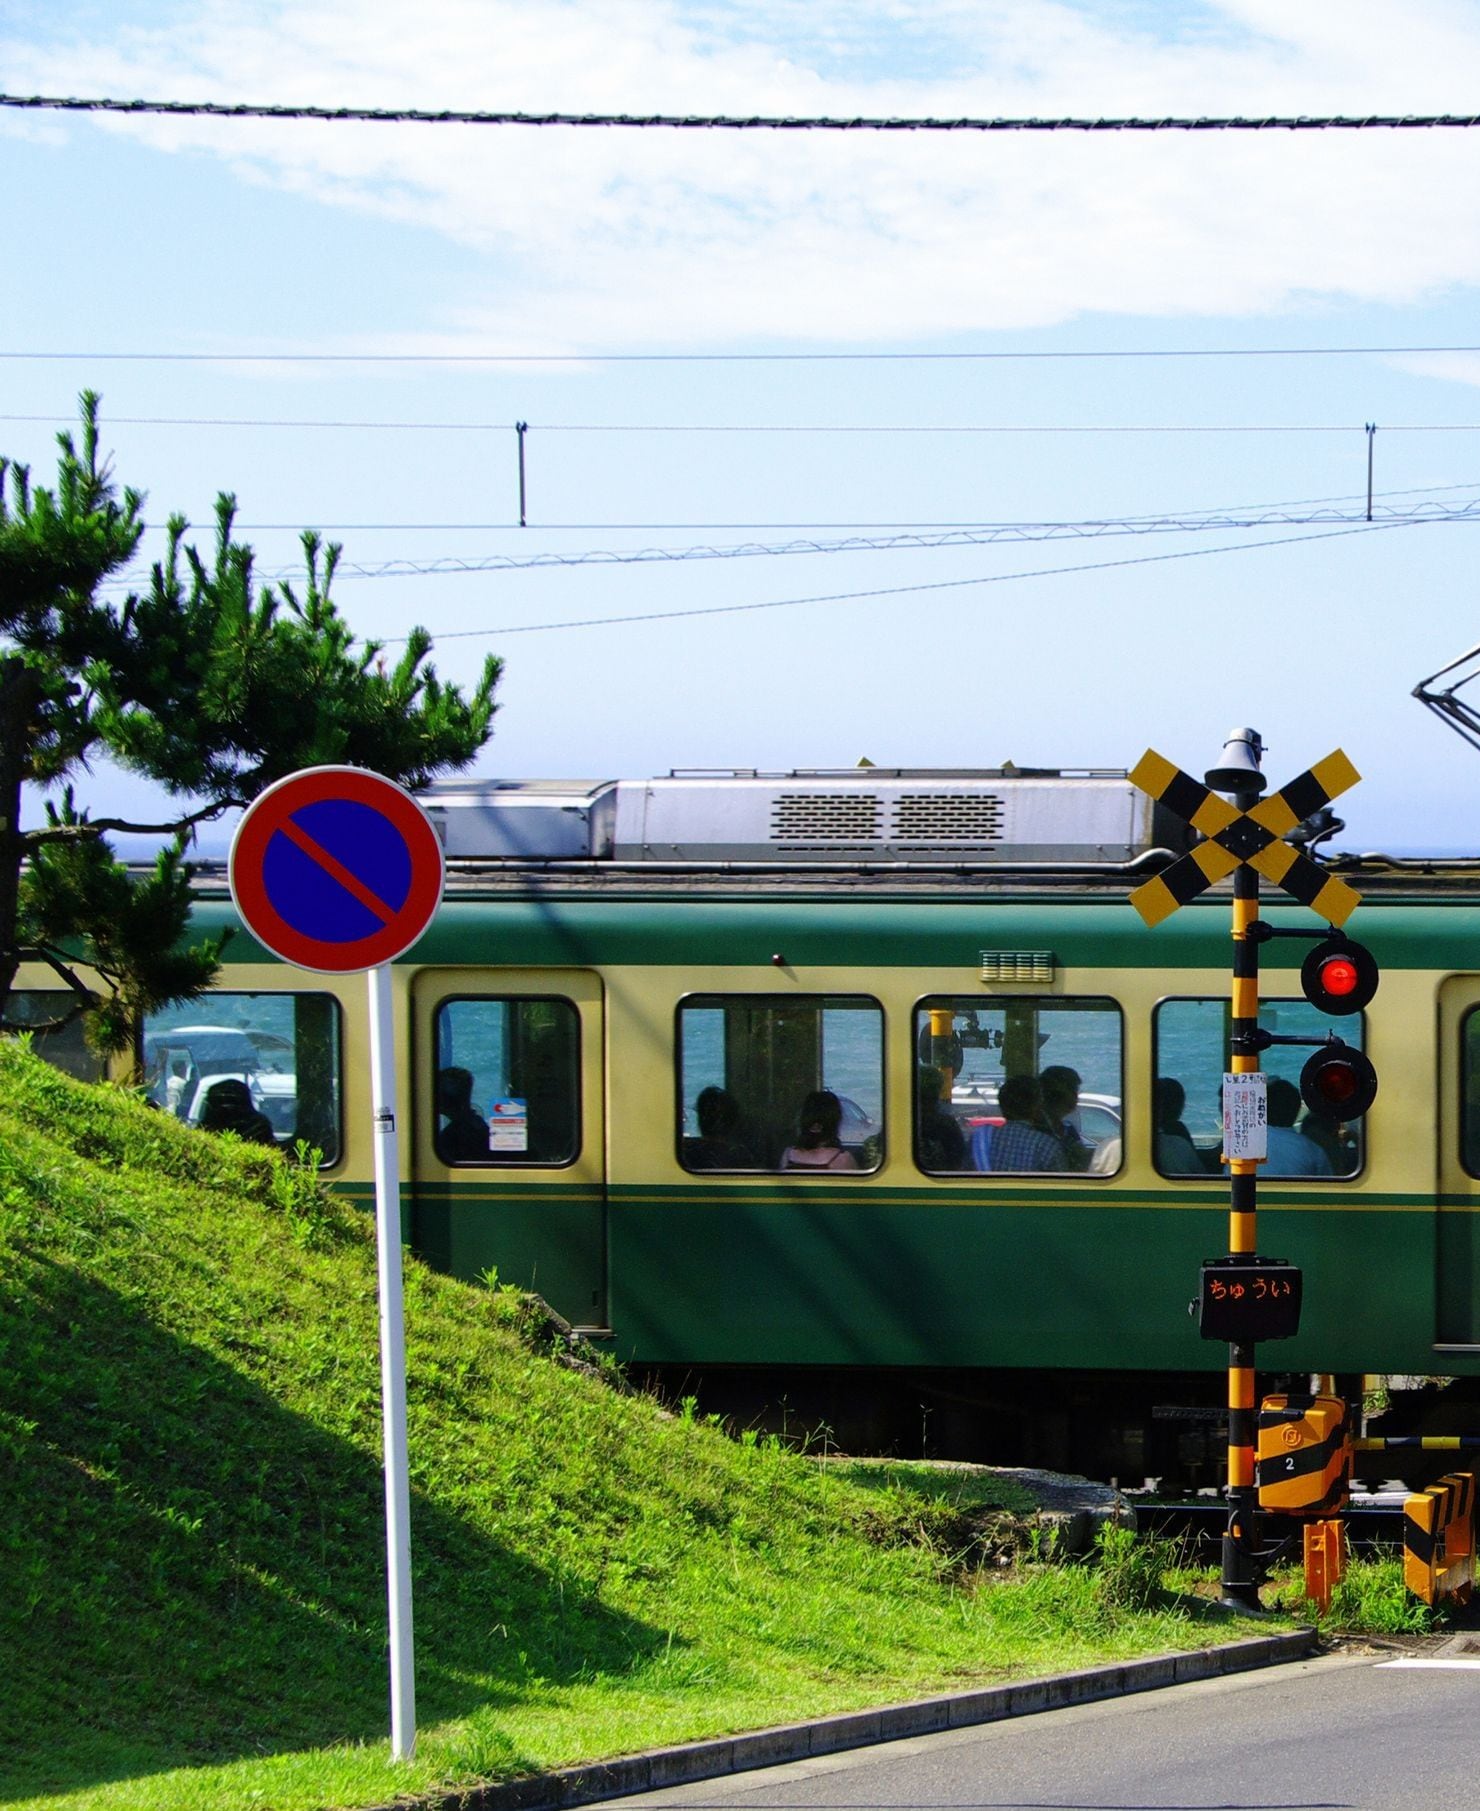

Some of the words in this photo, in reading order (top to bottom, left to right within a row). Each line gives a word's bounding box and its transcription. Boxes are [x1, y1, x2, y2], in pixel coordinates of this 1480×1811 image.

[1209, 1277, 1292, 1300] ちゅうい
[1285, 1457, 1295, 1470] 2
